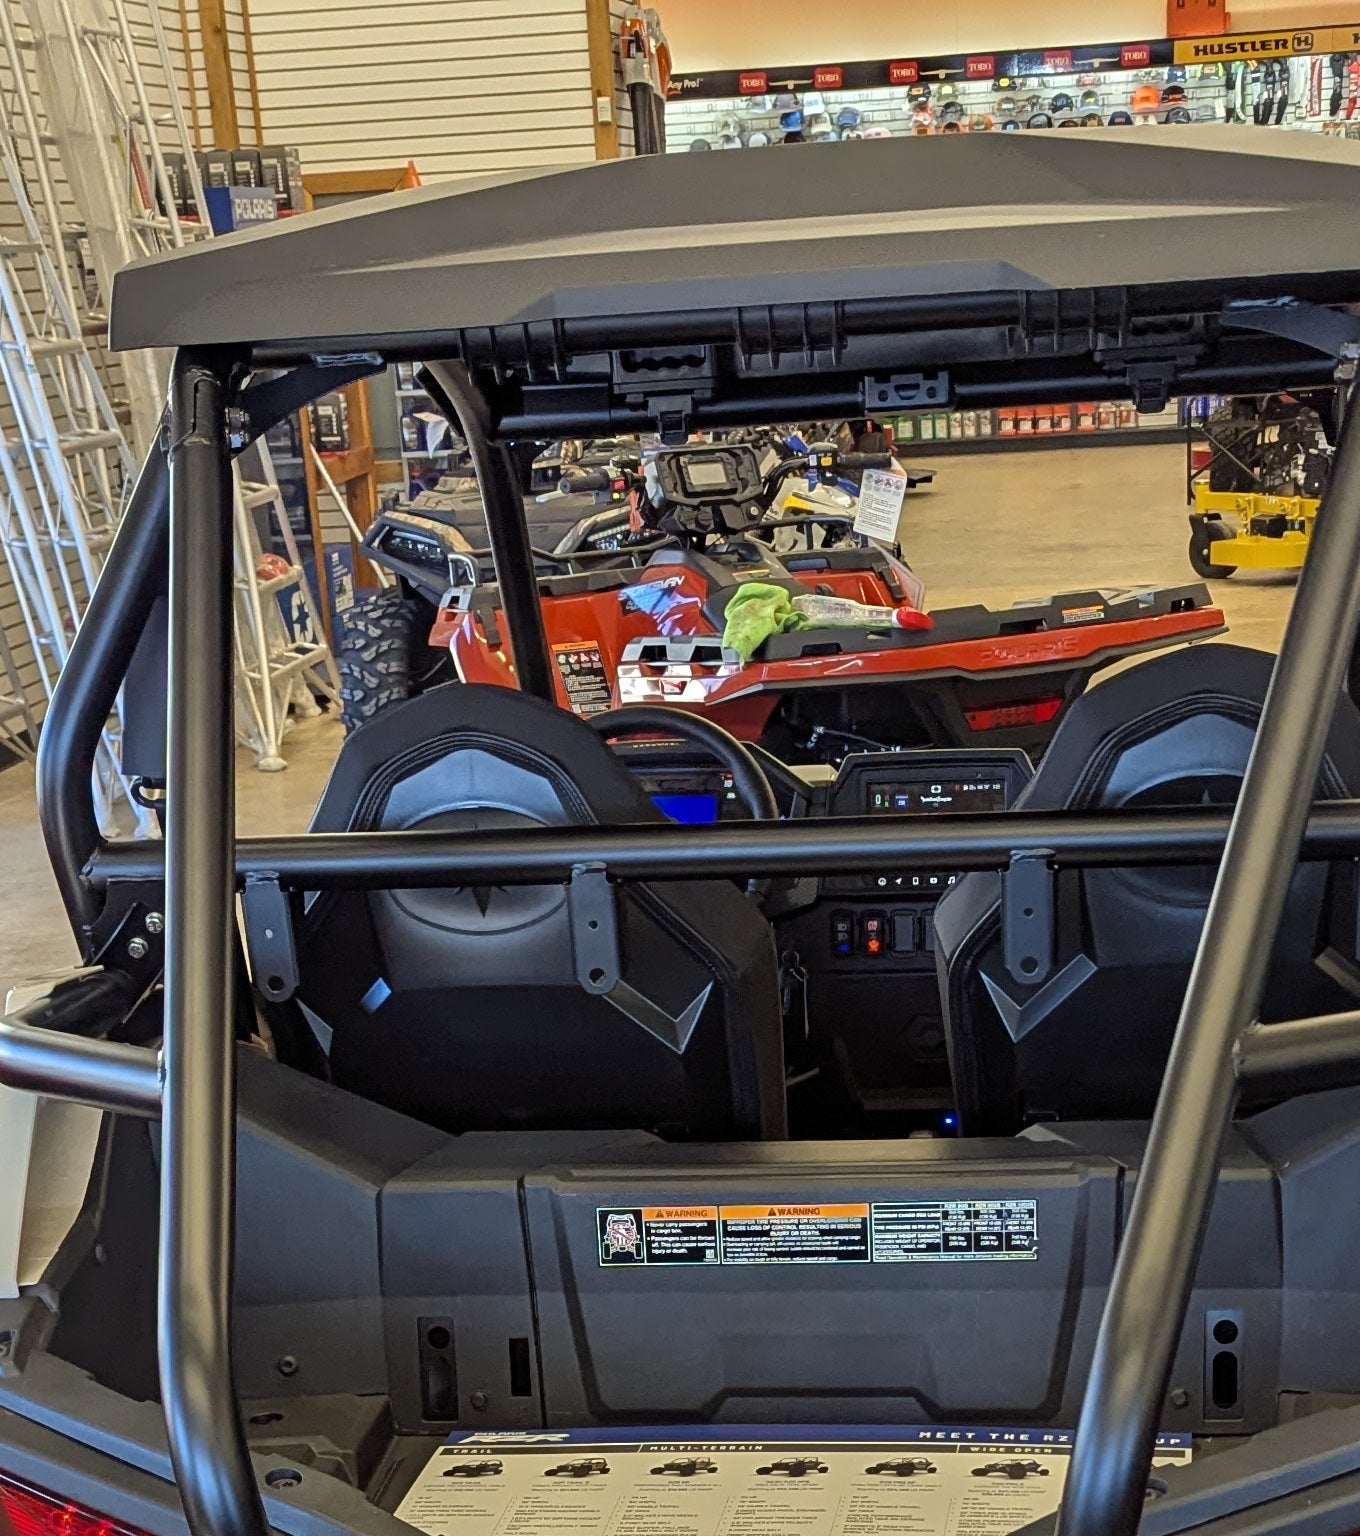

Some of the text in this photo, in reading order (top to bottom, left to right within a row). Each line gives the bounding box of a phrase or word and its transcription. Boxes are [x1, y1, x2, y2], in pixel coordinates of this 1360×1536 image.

[1193, 38, 1288, 57] HUSTLER
[1123, 51, 1147, 61] TORO
[1045, 56, 1069, 67] TORO
[968, 63, 992, 72] TORO
[892, 68, 915, 78] TORO
[741, 78, 764, 88] TORO
[816, 74, 839, 83] TORO
[235, 199, 275, 220] POLARIS
[665, 1209, 708, 1218] WARNING
[777, 1207, 821, 1216] WARNING
[919, 1430, 1070, 1443] MEET THE RZ
[649, 1444, 764, 1452] MULTI-TERRAIN
